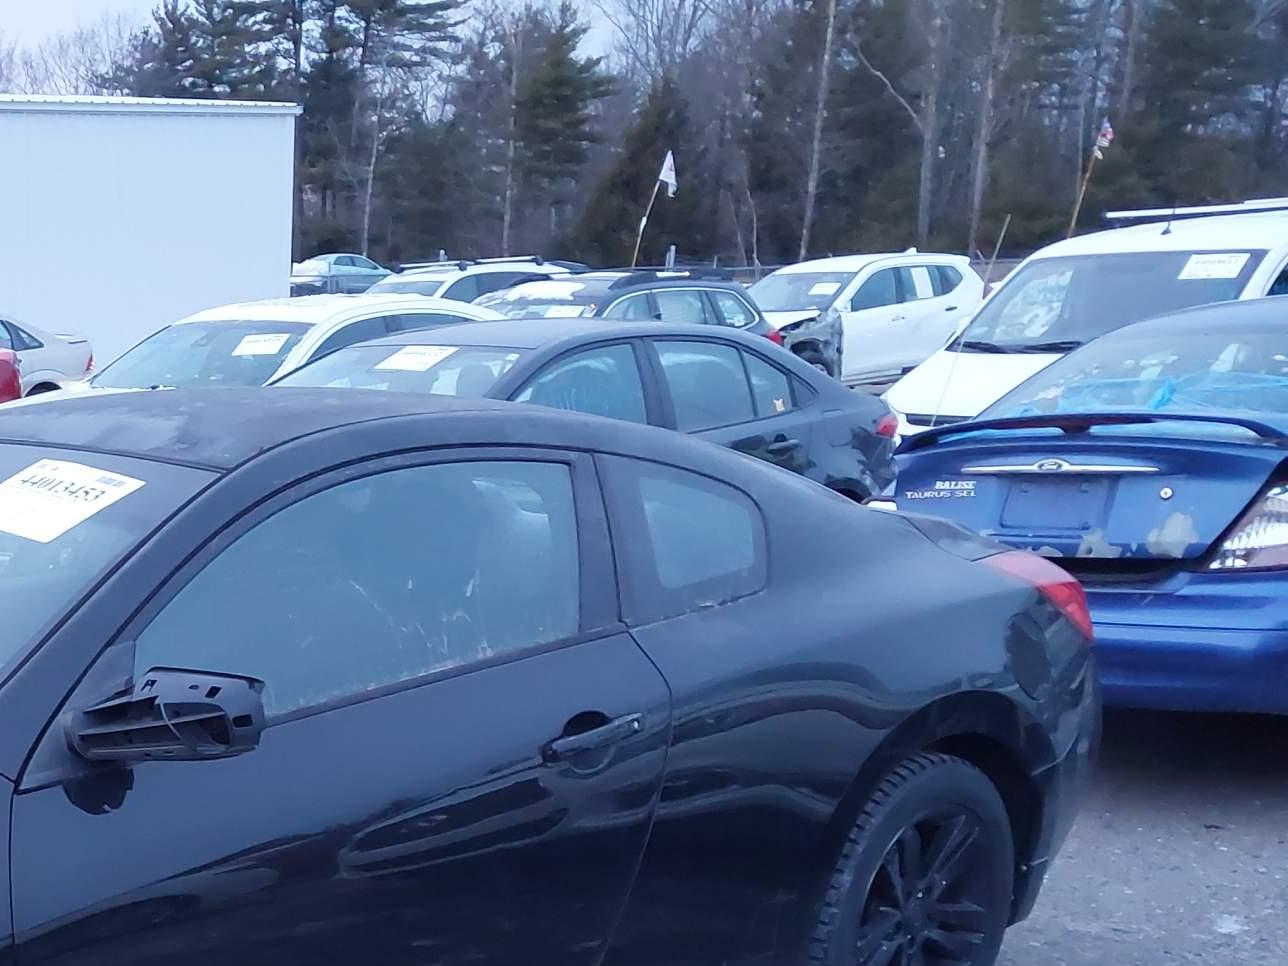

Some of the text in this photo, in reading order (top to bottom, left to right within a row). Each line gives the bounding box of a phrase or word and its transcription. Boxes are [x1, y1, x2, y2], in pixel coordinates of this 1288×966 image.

[20, 473, 107, 501] 44013453
[905, 489, 977, 499] TAURUS SEL
